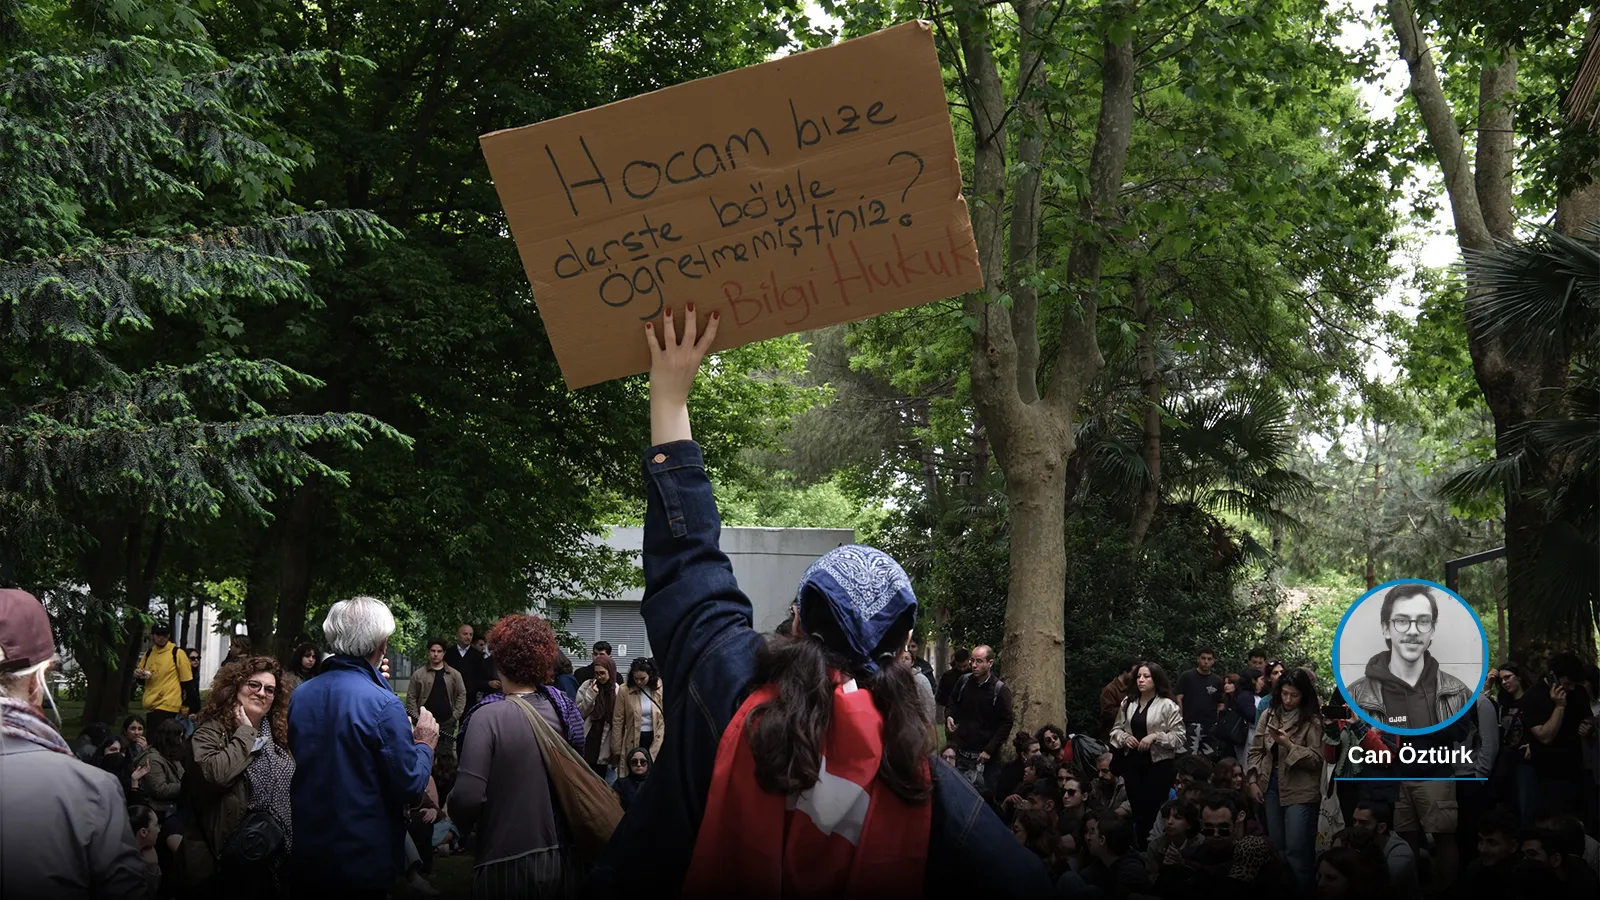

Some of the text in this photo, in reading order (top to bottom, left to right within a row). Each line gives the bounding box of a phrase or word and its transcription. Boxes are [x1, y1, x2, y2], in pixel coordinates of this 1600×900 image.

[544, 127, 770, 217] Hocam
[554, 169, 837, 279] derste böyle
[720, 225, 980, 327] Bilgi Hukuk
